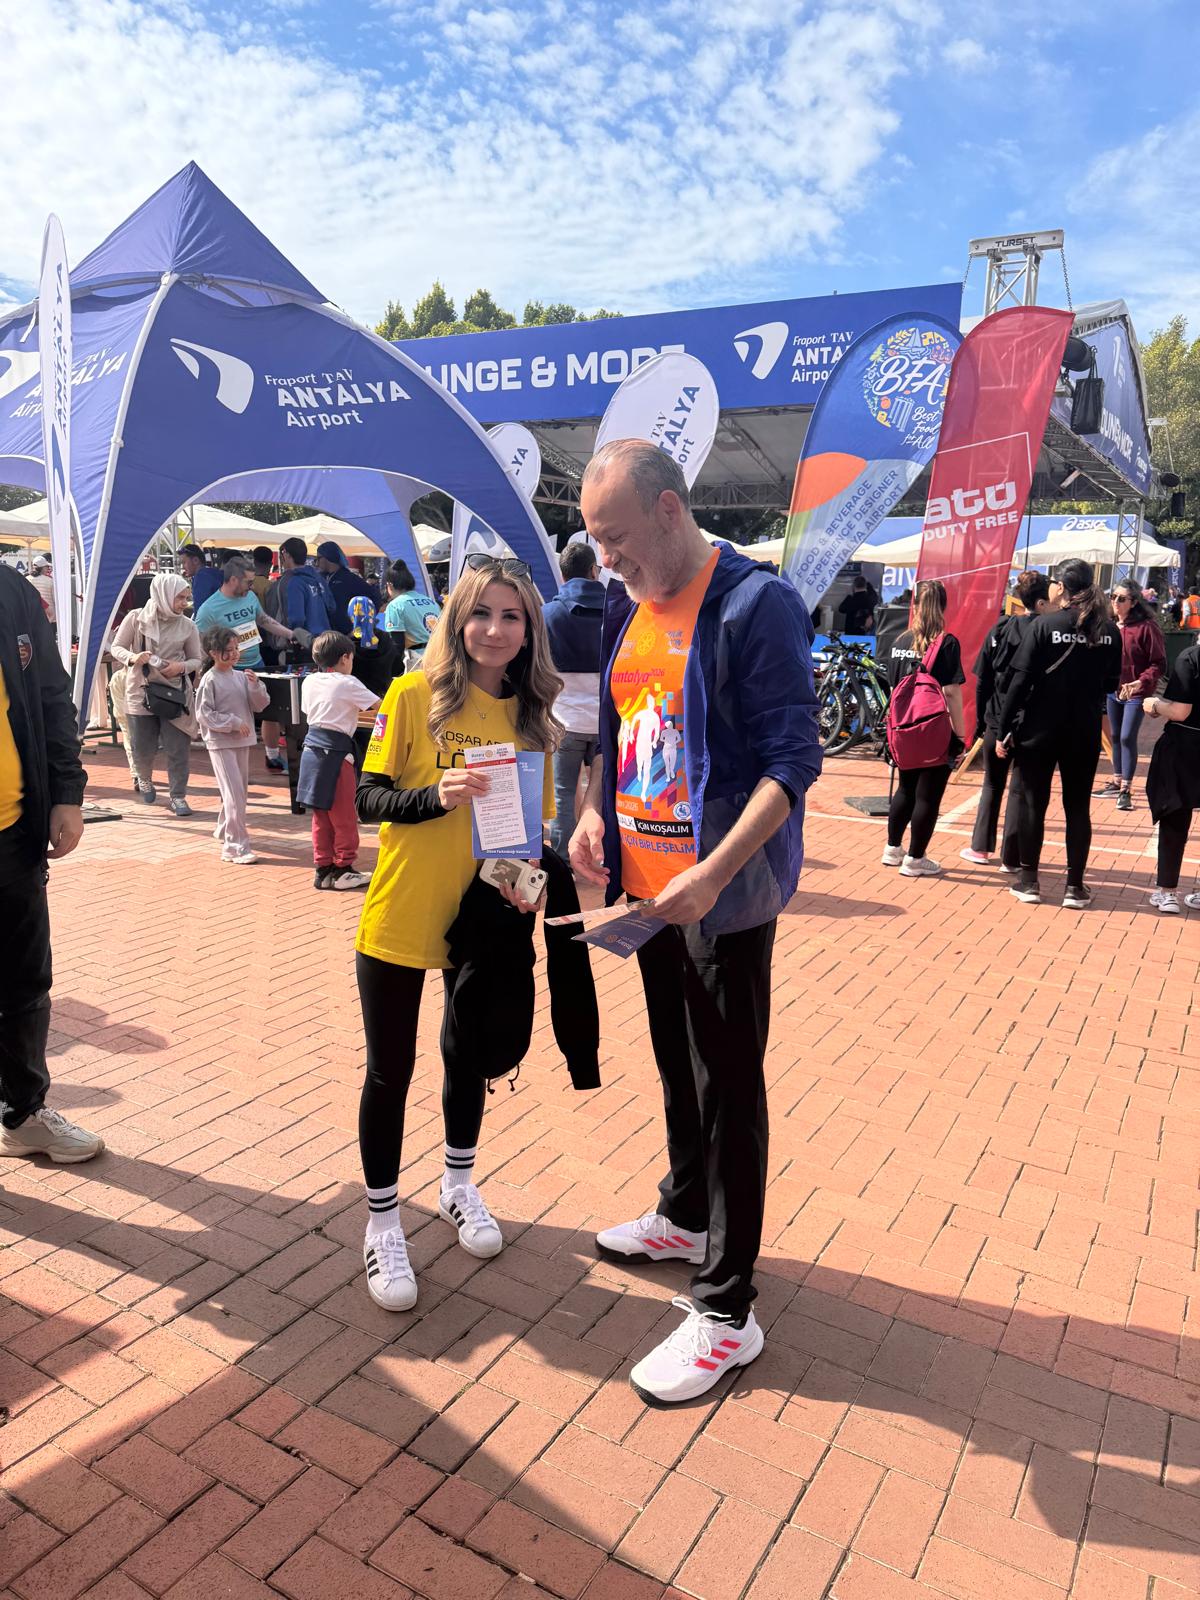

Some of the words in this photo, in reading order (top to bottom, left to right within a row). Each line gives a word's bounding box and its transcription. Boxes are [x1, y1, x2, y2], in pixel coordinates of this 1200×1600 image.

[995, 236, 1036, 247] TURSET
[792, 335, 826, 347] Fraport
[830, 331, 854, 343] TAV
[791, 345, 850, 366] ANTA
[264, 373, 317, 388] Fraport
[321, 368, 353, 385] TAV
[425, 358, 522, 394] UNGE
[531, 356, 557, 388] &
[277, 380, 412, 408] ANTALYA
[287, 409, 364, 430] Airport
[650, 411, 667, 438] TAV
[659, 386, 701, 456] TALYA
[911, 406, 942, 422] Best
[912, 421, 942, 434] Food
[796, 546, 820, 579] FOOD
[825, 479, 872, 537] BEVERAGE
[806, 520, 856, 586] EXPERIENCE
[853, 469, 899, 521] DESIGNER
[924, 520, 969, 543] DUTY
[974, 510, 1019, 531] FREE
[816, 576, 830, 593] OF
[828, 530, 866, 578] ANTALYA
[864, 483, 905, 531] AIRPORT
[223, 605, 254, 622] TEGV
[650, 824, 689, 835] KOŞALIM
